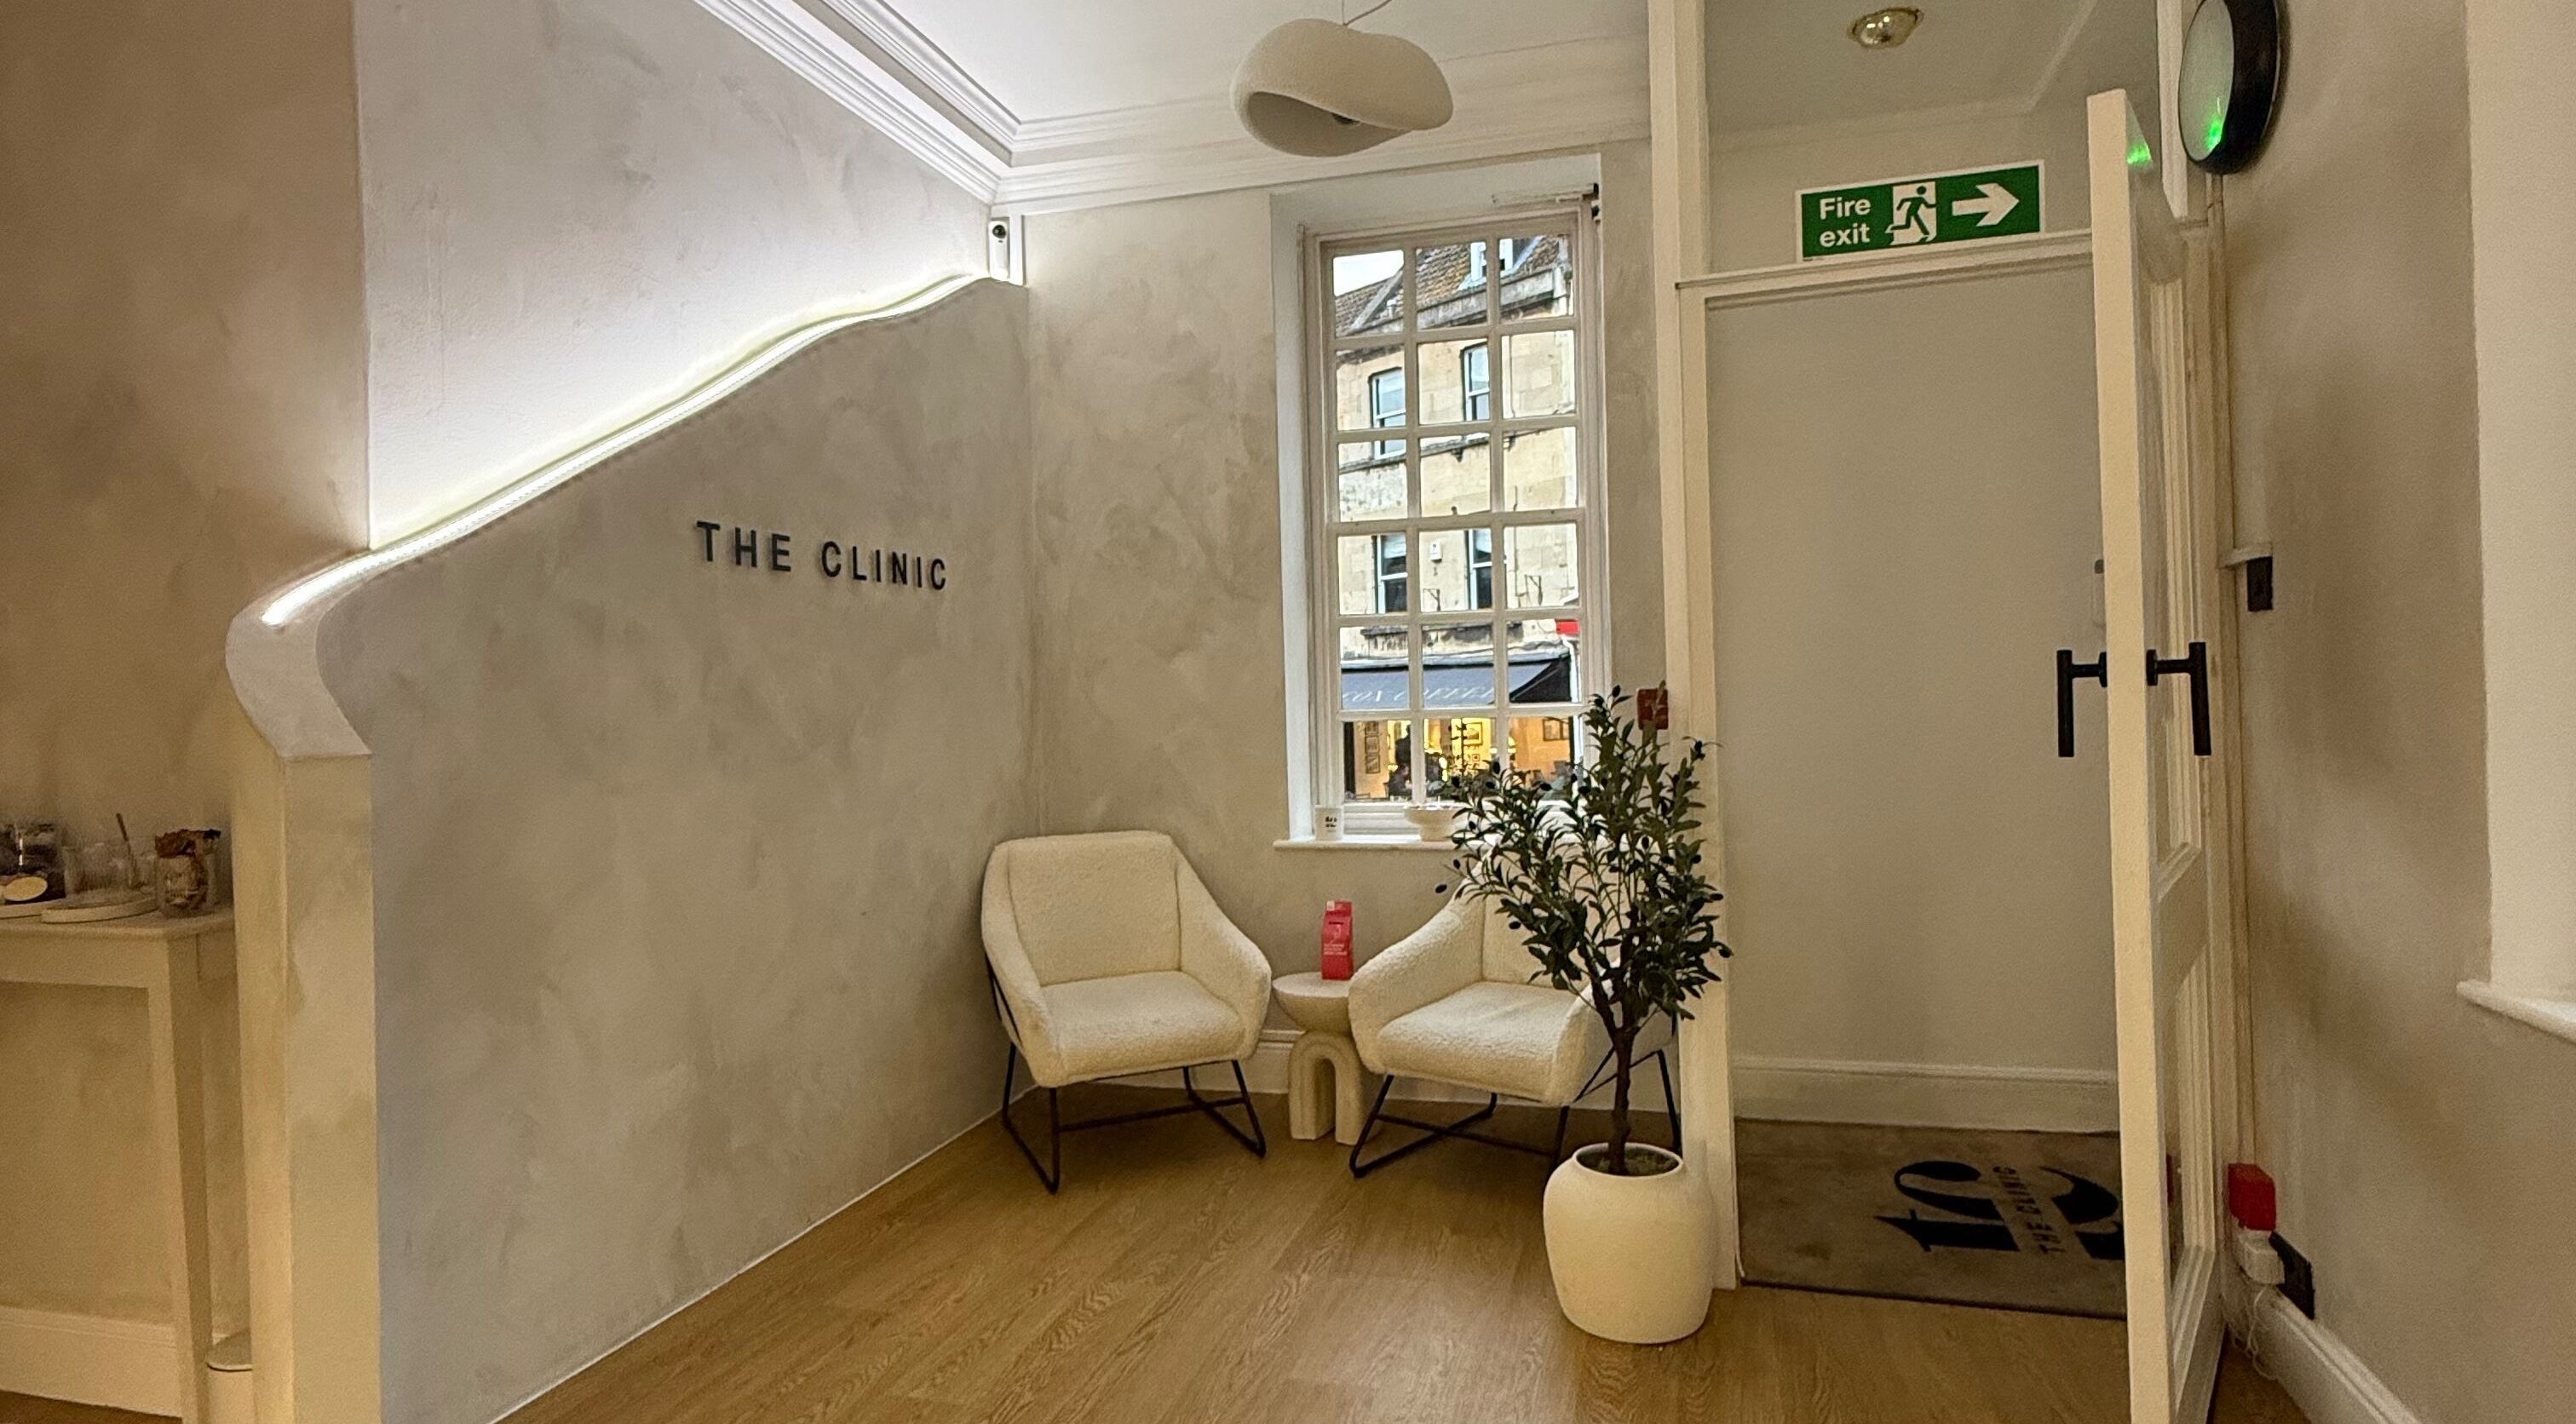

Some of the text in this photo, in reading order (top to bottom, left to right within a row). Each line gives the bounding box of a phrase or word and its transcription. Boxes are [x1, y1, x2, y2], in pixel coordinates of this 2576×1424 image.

[1820, 196, 1872, 220] Fire
[1819, 222, 1871, 247] exit
[696, 520, 946, 590] THE CLINIC
[1992, 1165, 2066, 1255] THE CLINIC
